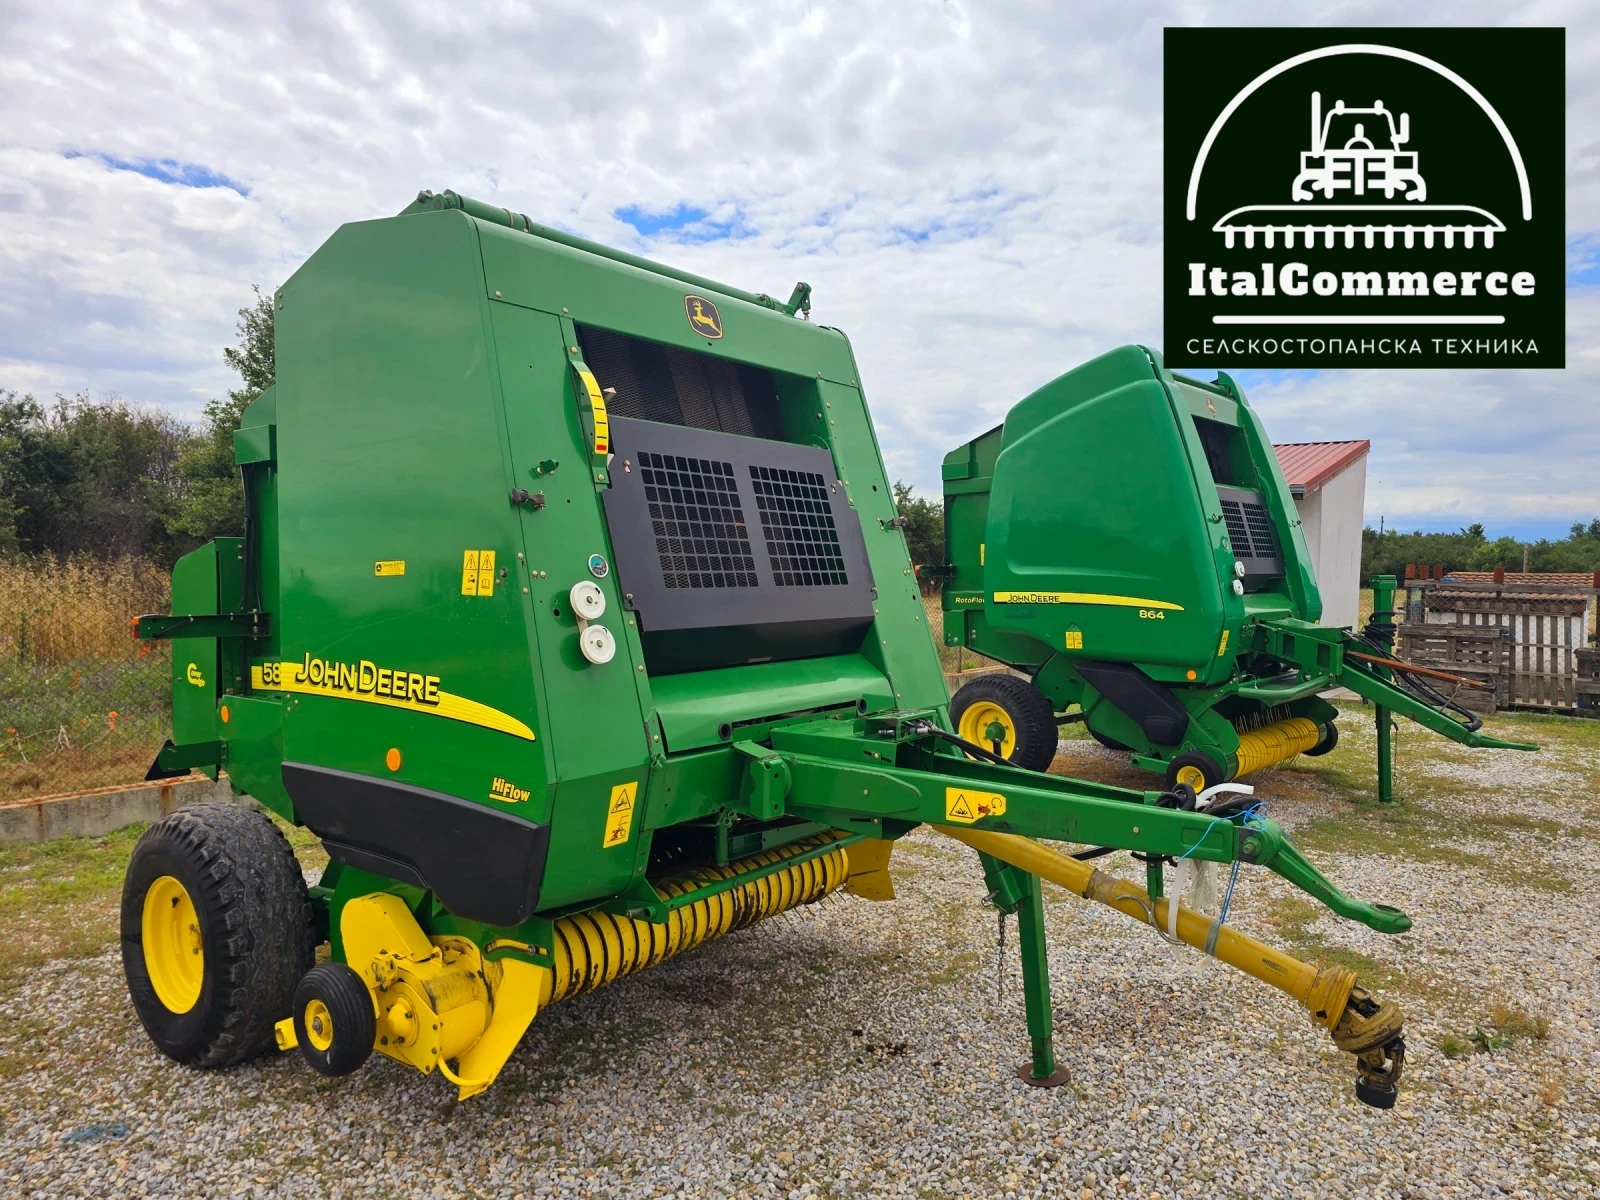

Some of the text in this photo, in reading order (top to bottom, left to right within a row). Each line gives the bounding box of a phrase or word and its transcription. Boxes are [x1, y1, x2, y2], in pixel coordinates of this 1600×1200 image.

[1007, 593, 1061, 604] JOHN DEERE
[1138, 609, 1165, 620] 864
[296, 652, 441, 706] JOHN DEERE
[491, 776, 531, 802] HiFlow
